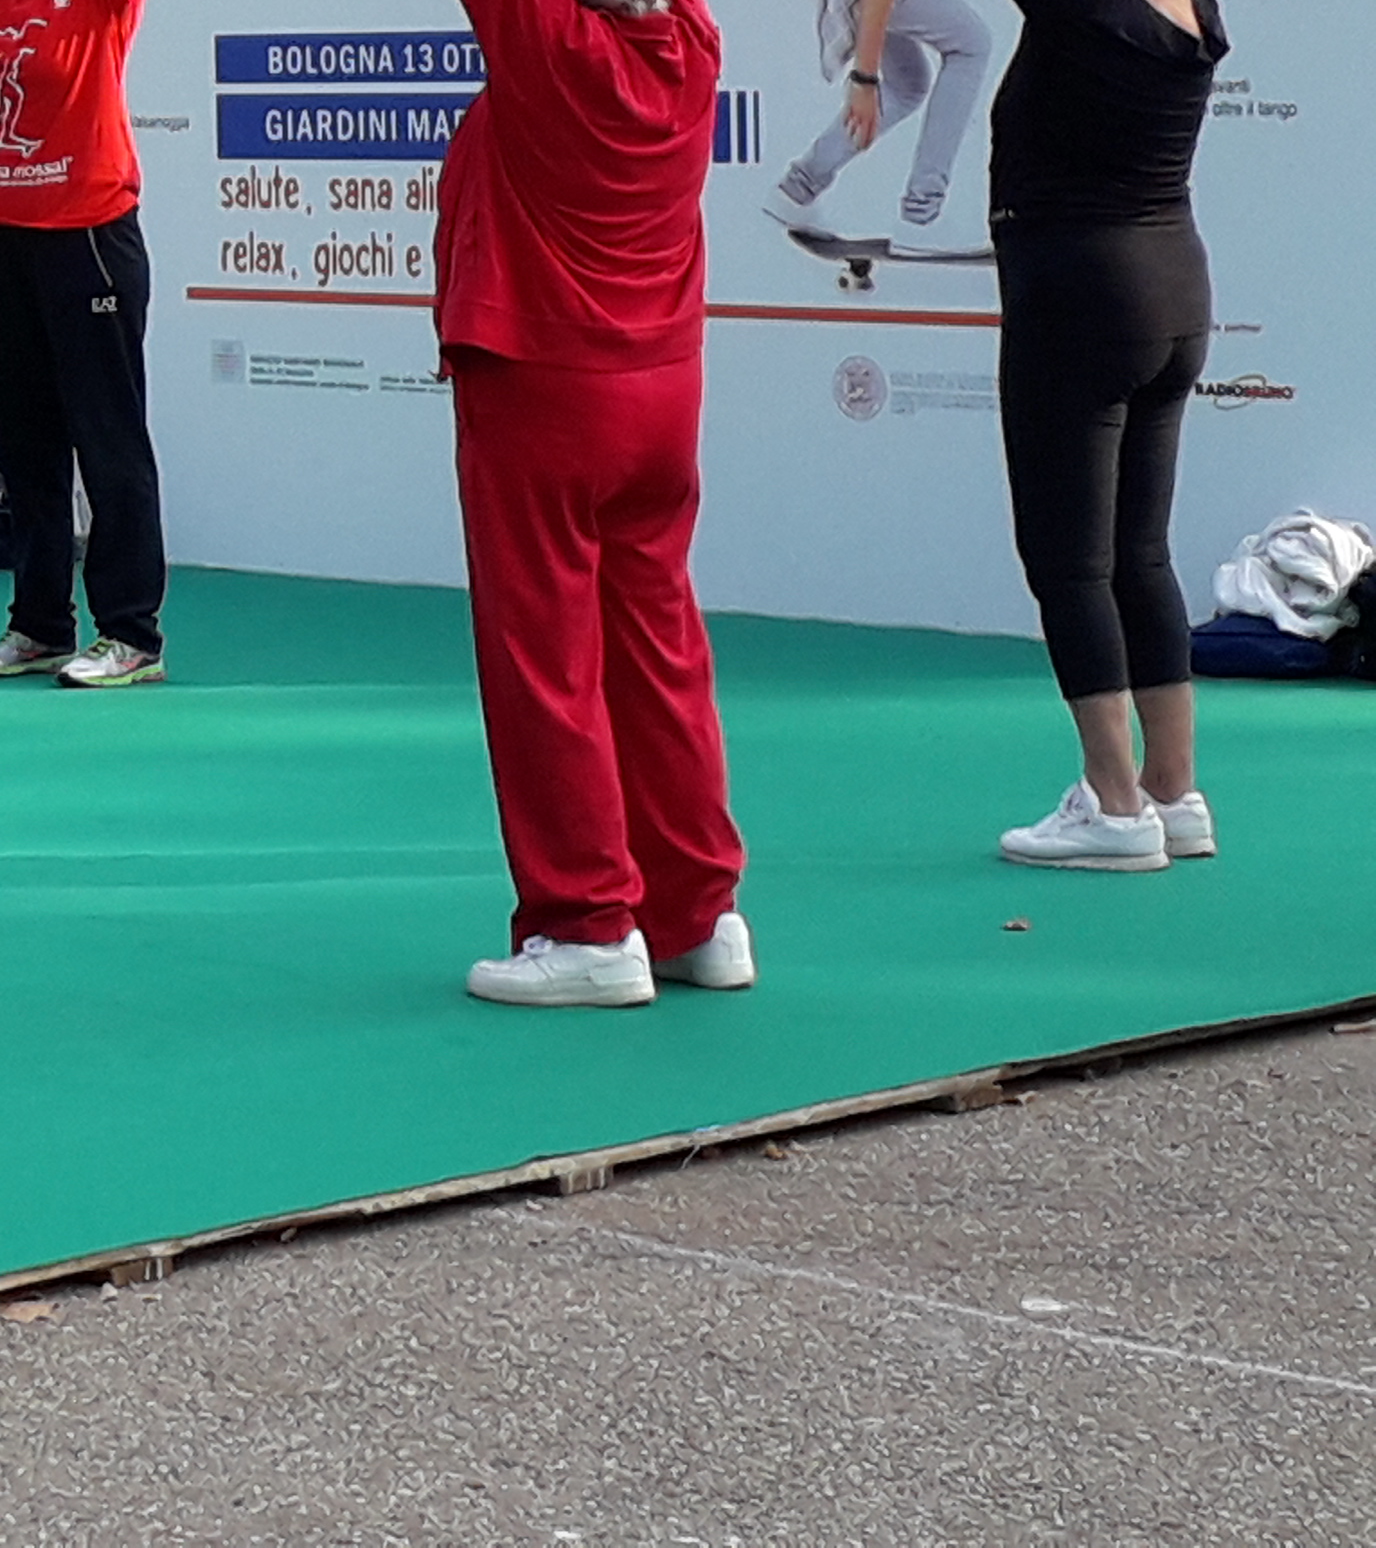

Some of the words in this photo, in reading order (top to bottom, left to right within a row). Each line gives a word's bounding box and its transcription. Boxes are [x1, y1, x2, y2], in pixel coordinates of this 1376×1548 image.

[267, 44, 395, 75] BOLOGNA
[403, 43, 435, 74] 13
[442, 43, 488, 74] OTT
[264, 107, 398, 142] GIARDINI
[220, 164, 313, 216] salute,
[328, 176, 394, 211] sana
[405, 166, 435, 212] ali
[221, 230, 298, 280] relax,
[313, 230, 394, 287] giochi
[405, 244, 422, 277] e
